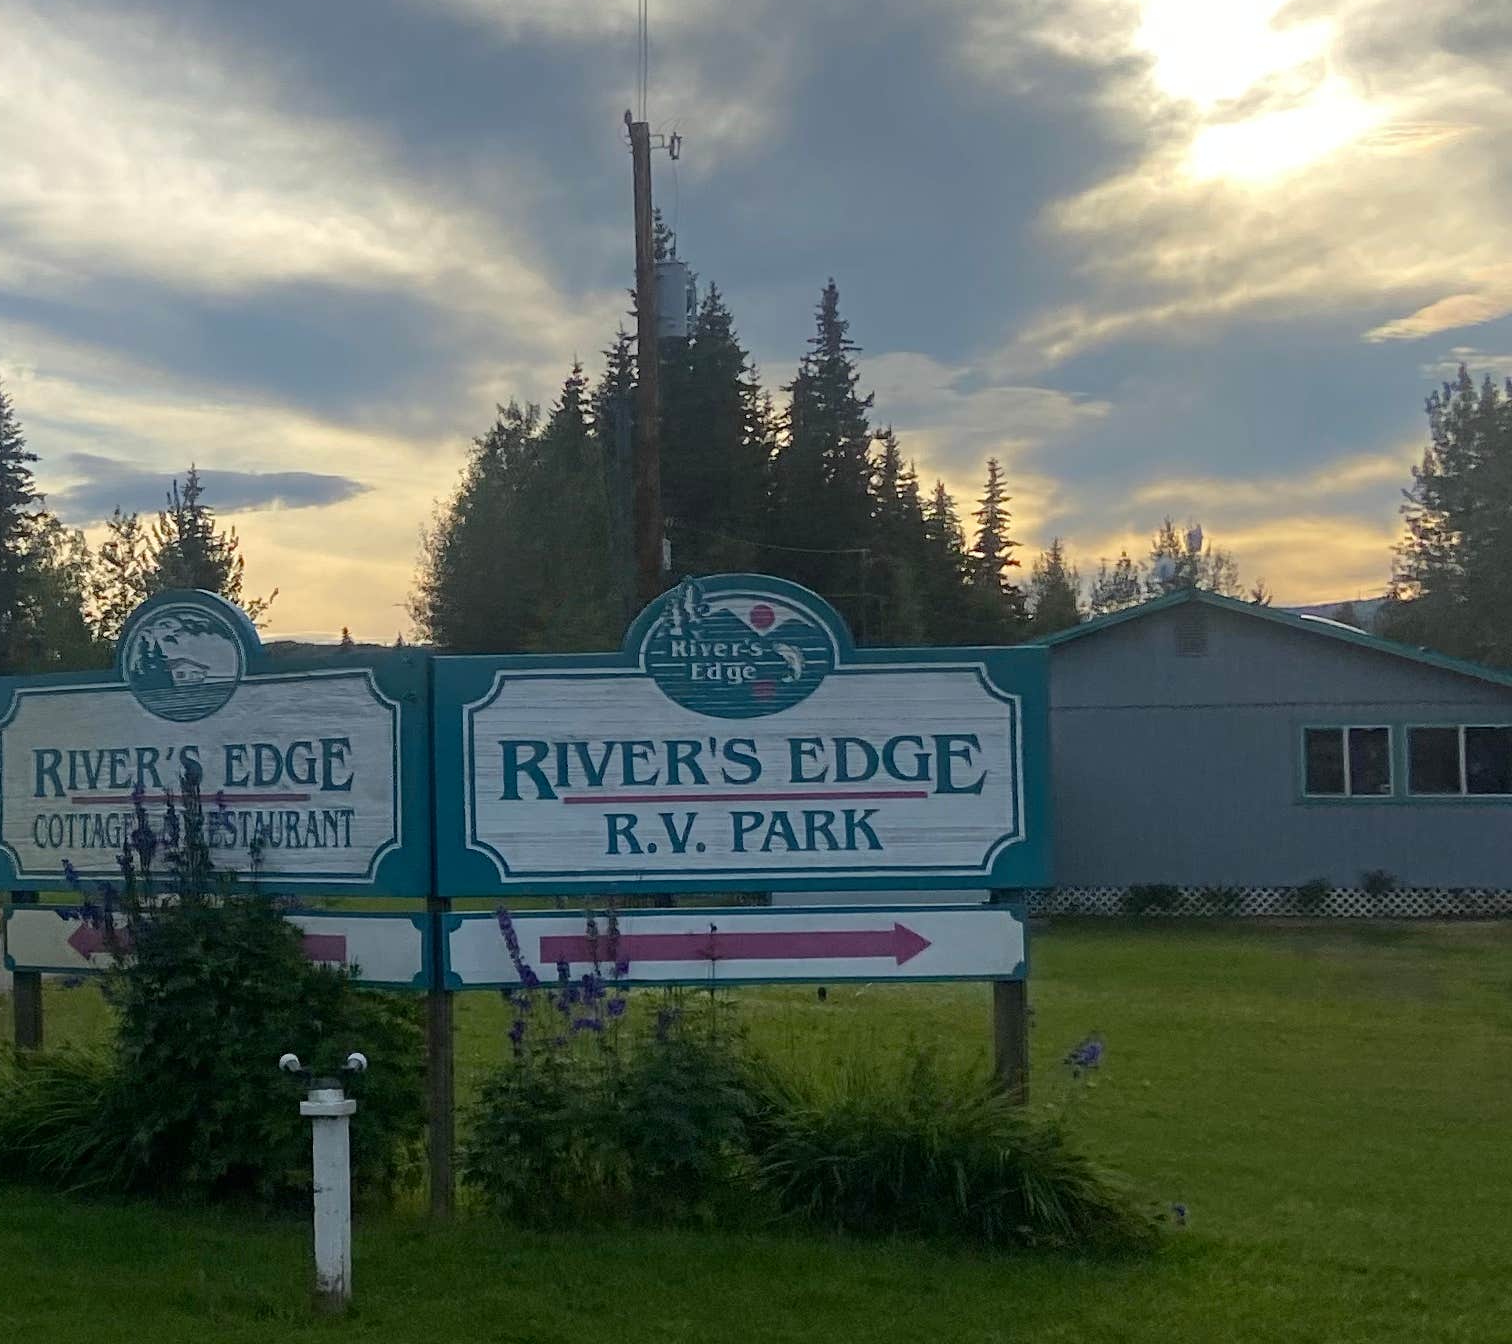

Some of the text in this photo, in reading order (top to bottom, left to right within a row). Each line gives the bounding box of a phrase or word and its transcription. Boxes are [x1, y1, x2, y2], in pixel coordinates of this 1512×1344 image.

[671, 639, 764, 657] River's
[690, 661, 758, 685] Edge
[33, 736, 355, 798] RIVER'S EDGE
[498, 732, 988, 801] RIVER'S EDGE
[186, 807, 355, 849] ESTAURANT
[604, 808, 884, 856] R.V. PARK
